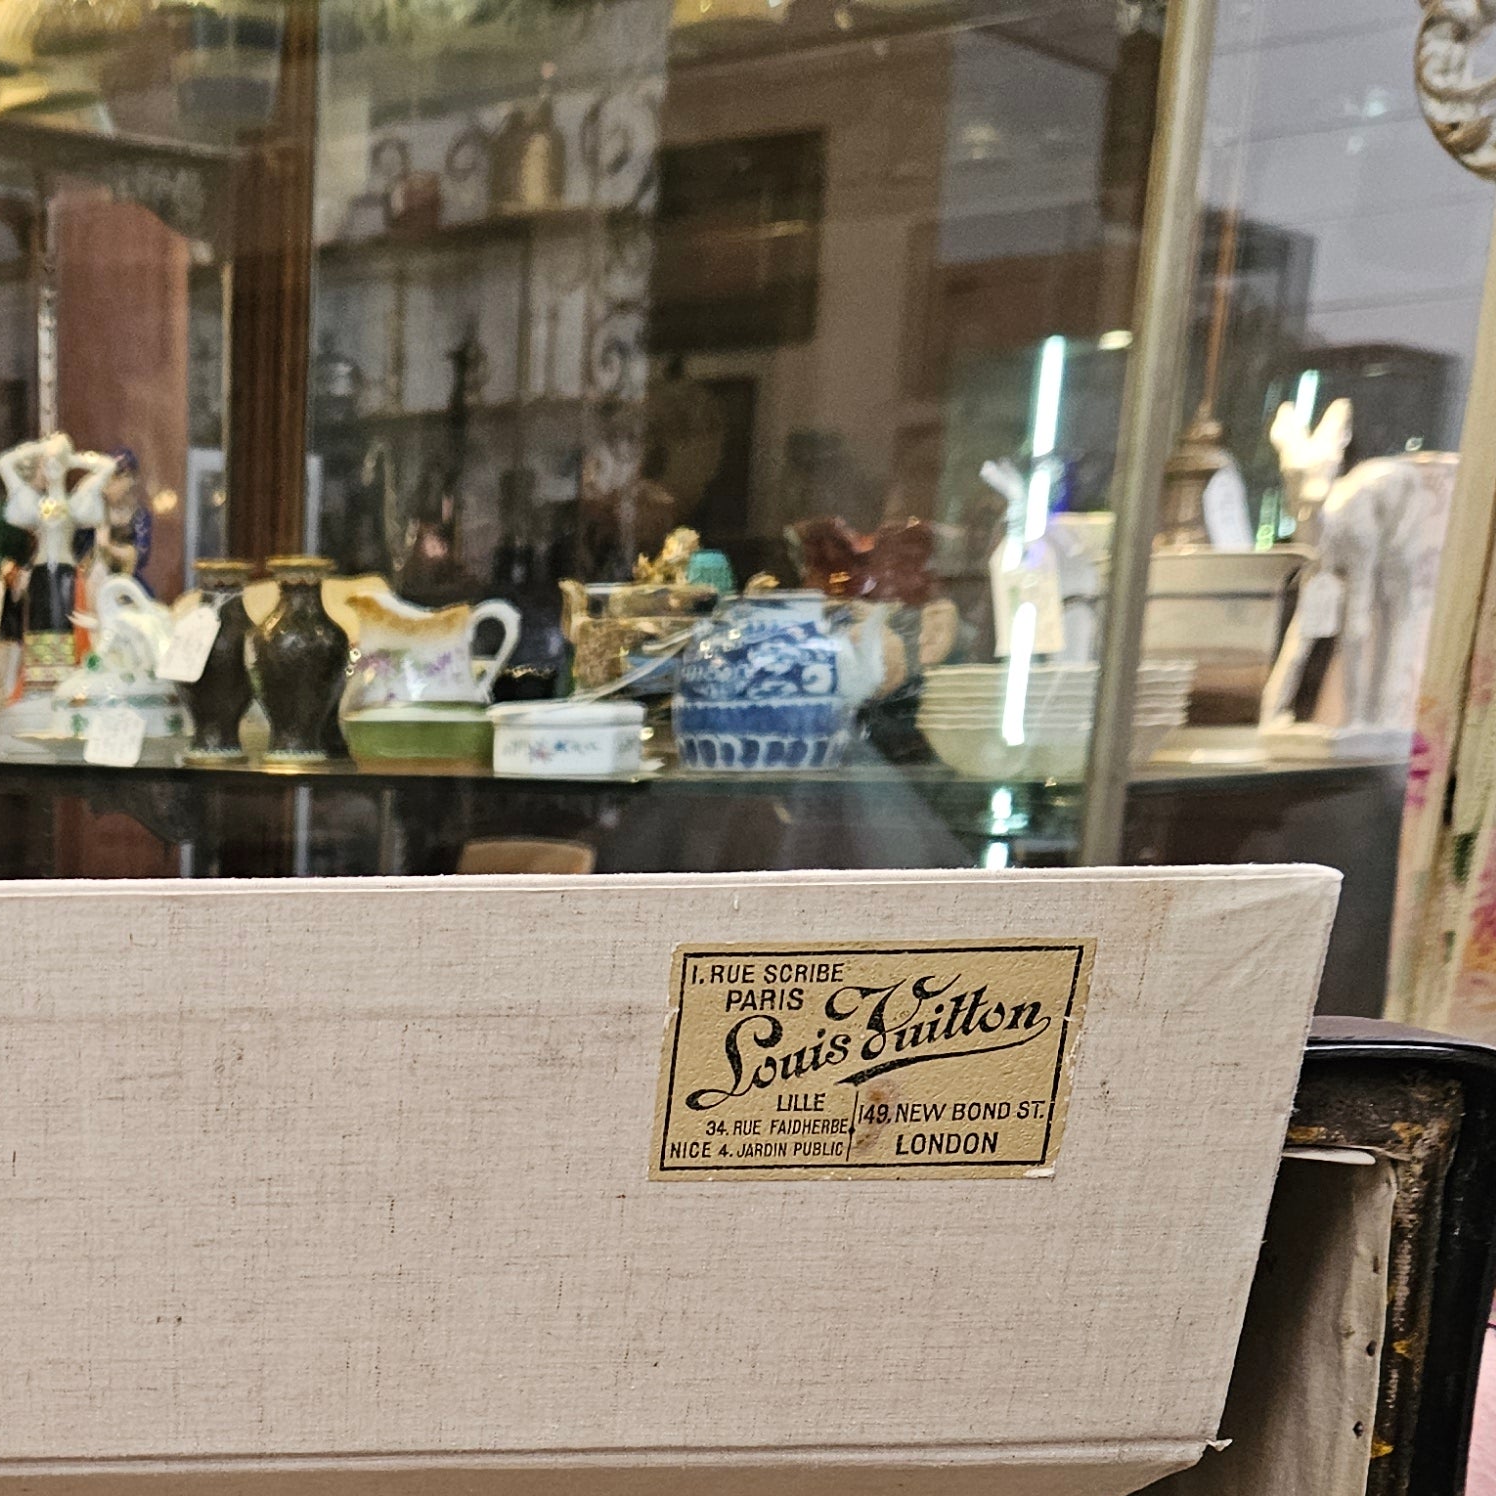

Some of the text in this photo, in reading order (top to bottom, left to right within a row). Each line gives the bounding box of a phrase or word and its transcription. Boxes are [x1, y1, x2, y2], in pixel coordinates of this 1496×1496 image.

[710, 965, 754, 983] RUE
[764, 963, 844, 983] SCRIBE
[726, 989, 803, 1011] PARIS
[685, 974, 1051, 1110] Louis Vuitton
[777, 1094, 826, 1112] LILLE
[858, 1101, 1044, 1124] 149. NEW BOND ST.
[734, 1120, 760, 1135] RUE
[770, 1119, 848, 1135] FAIDHERBE
[670, 1142, 711, 1159] NICE
[737, 1142, 787, 1157] JARDIN
[793, 1141, 844, 1157] PUBLIC
[896, 1134, 999, 1155] LONDON
